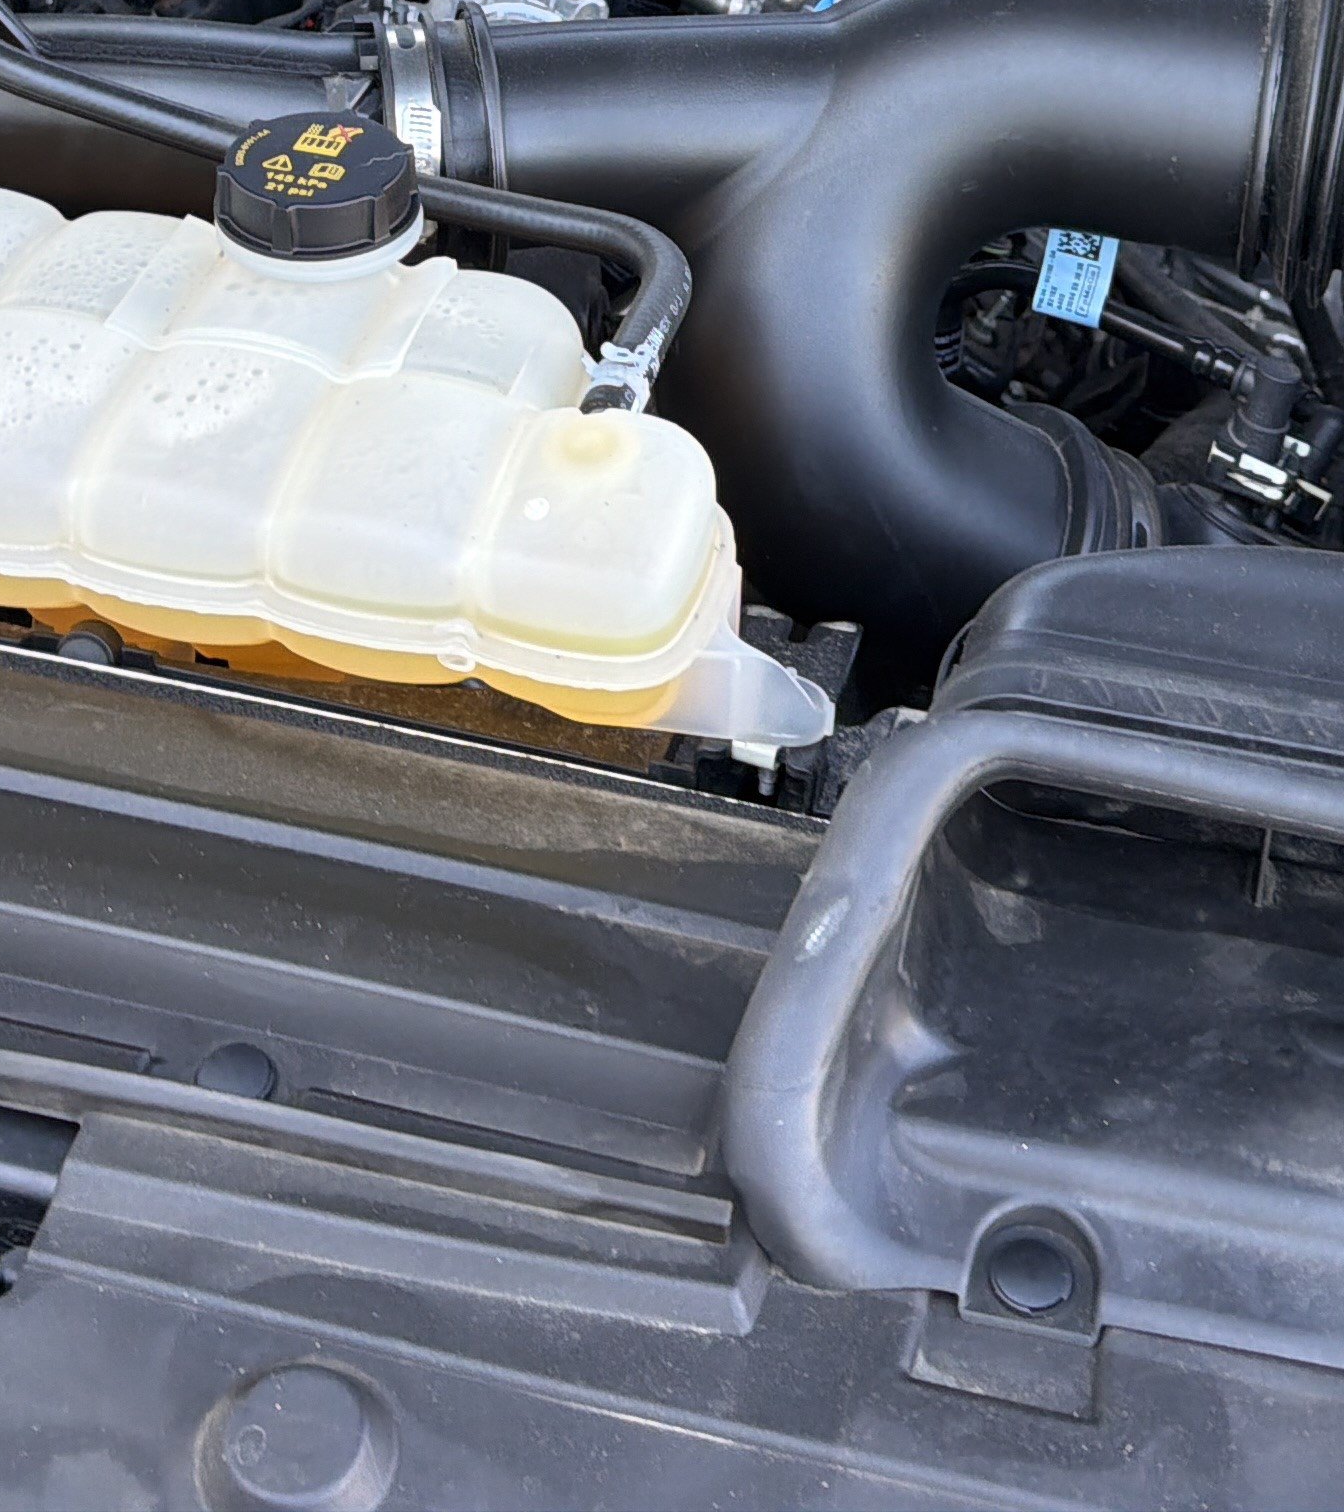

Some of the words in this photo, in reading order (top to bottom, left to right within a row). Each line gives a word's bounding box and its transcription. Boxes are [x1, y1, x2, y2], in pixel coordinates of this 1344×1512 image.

[264, 181, 285, 192] 21
[287, 187, 315, 197] psi
[297, 176, 328, 189] kPa
